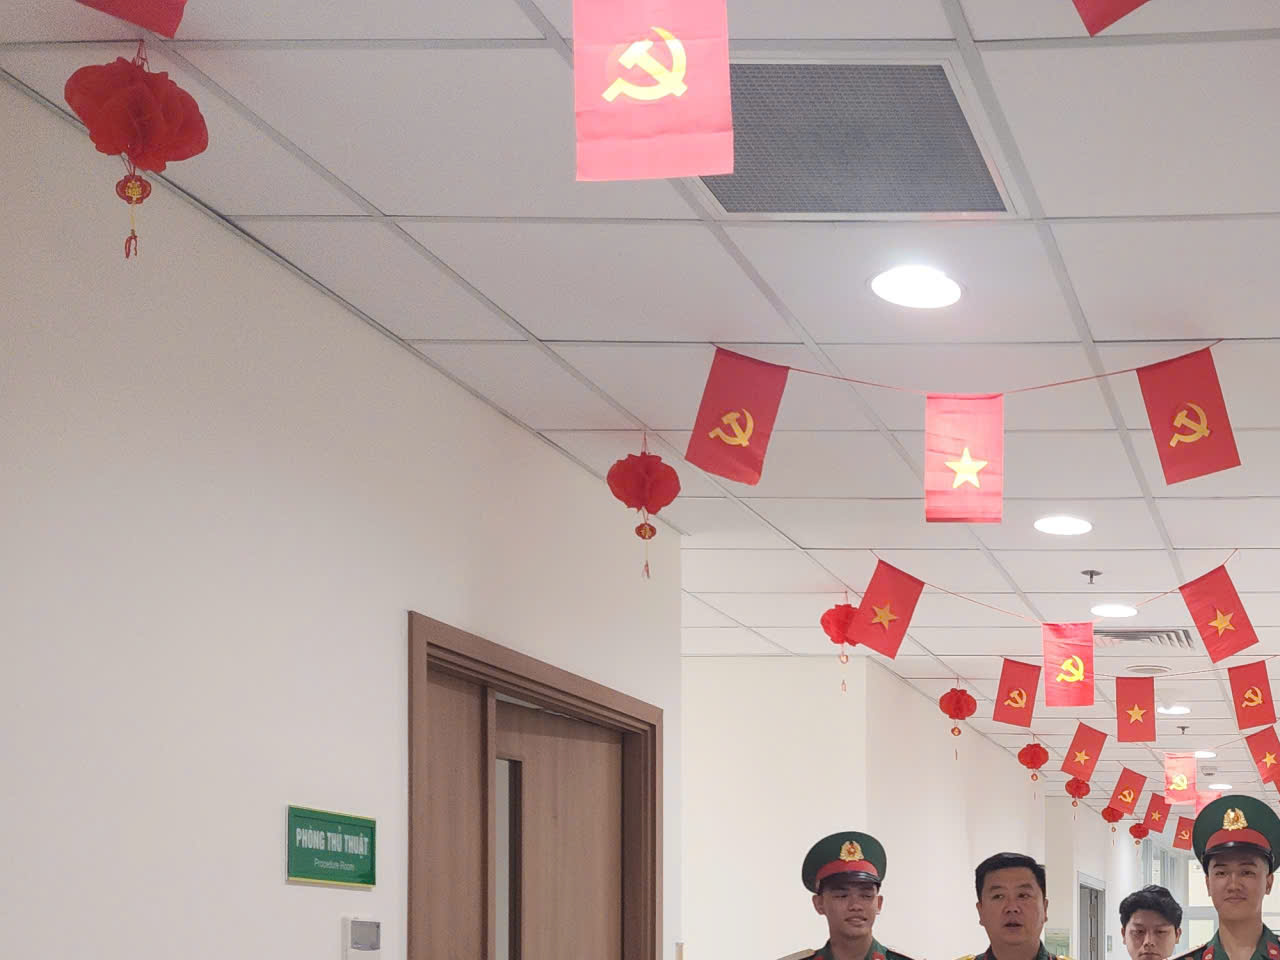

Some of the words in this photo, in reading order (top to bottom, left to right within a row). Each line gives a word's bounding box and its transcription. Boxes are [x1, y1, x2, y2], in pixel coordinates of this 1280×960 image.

[296, 825, 325, 850] PHÒNG
[327, 826, 343, 853] THỦ
[344, 832, 369, 859] THUẬT
